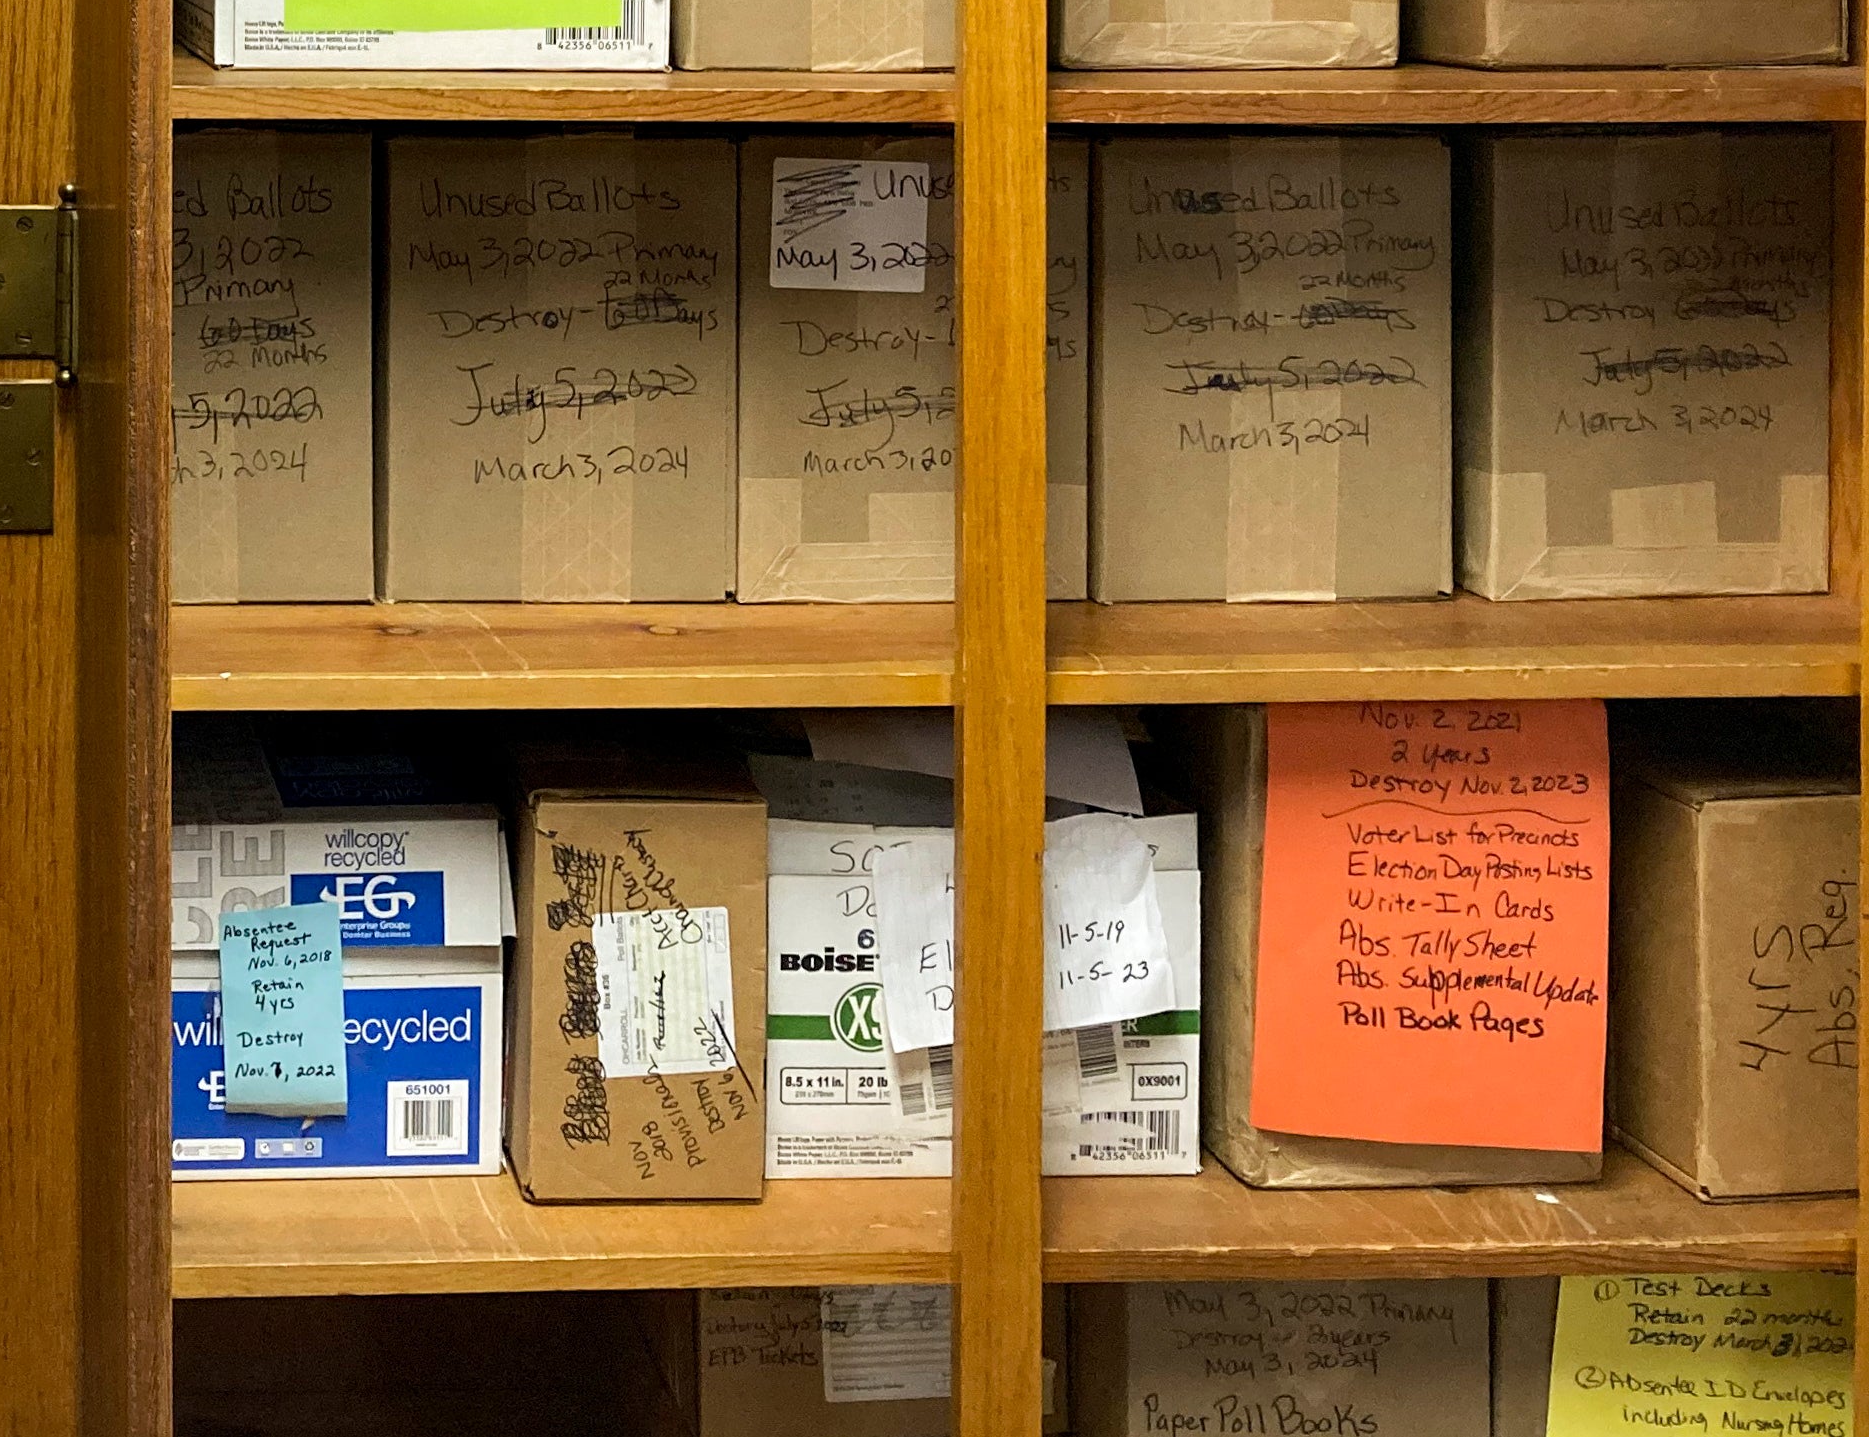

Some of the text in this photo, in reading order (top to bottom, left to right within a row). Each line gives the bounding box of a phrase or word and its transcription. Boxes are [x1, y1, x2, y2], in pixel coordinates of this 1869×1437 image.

[1346, 823, 1411, 846] Voter
[1412, 825, 1458, 845] List
[1464, 825, 1496, 846] for
[324, 829, 405, 870] willcopy recycled
[1346, 850, 1438, 880] Election
[1443, 855, 1484, 891] Day
[1544, 856, 1594, 882] Lists
[1495, 892, 1556, 922] Cards
[224, 919, 297, 941] Absentee
[250, 933, 312, 957] Request
[1342, 1000, 1545, 1042] Poll Book Pages
[237, 1030, 304, 1049] Destroy
[405, 1084, 451, 1095] 651001
[1143, 1394, 1380, 1435] Paper Poll Books
